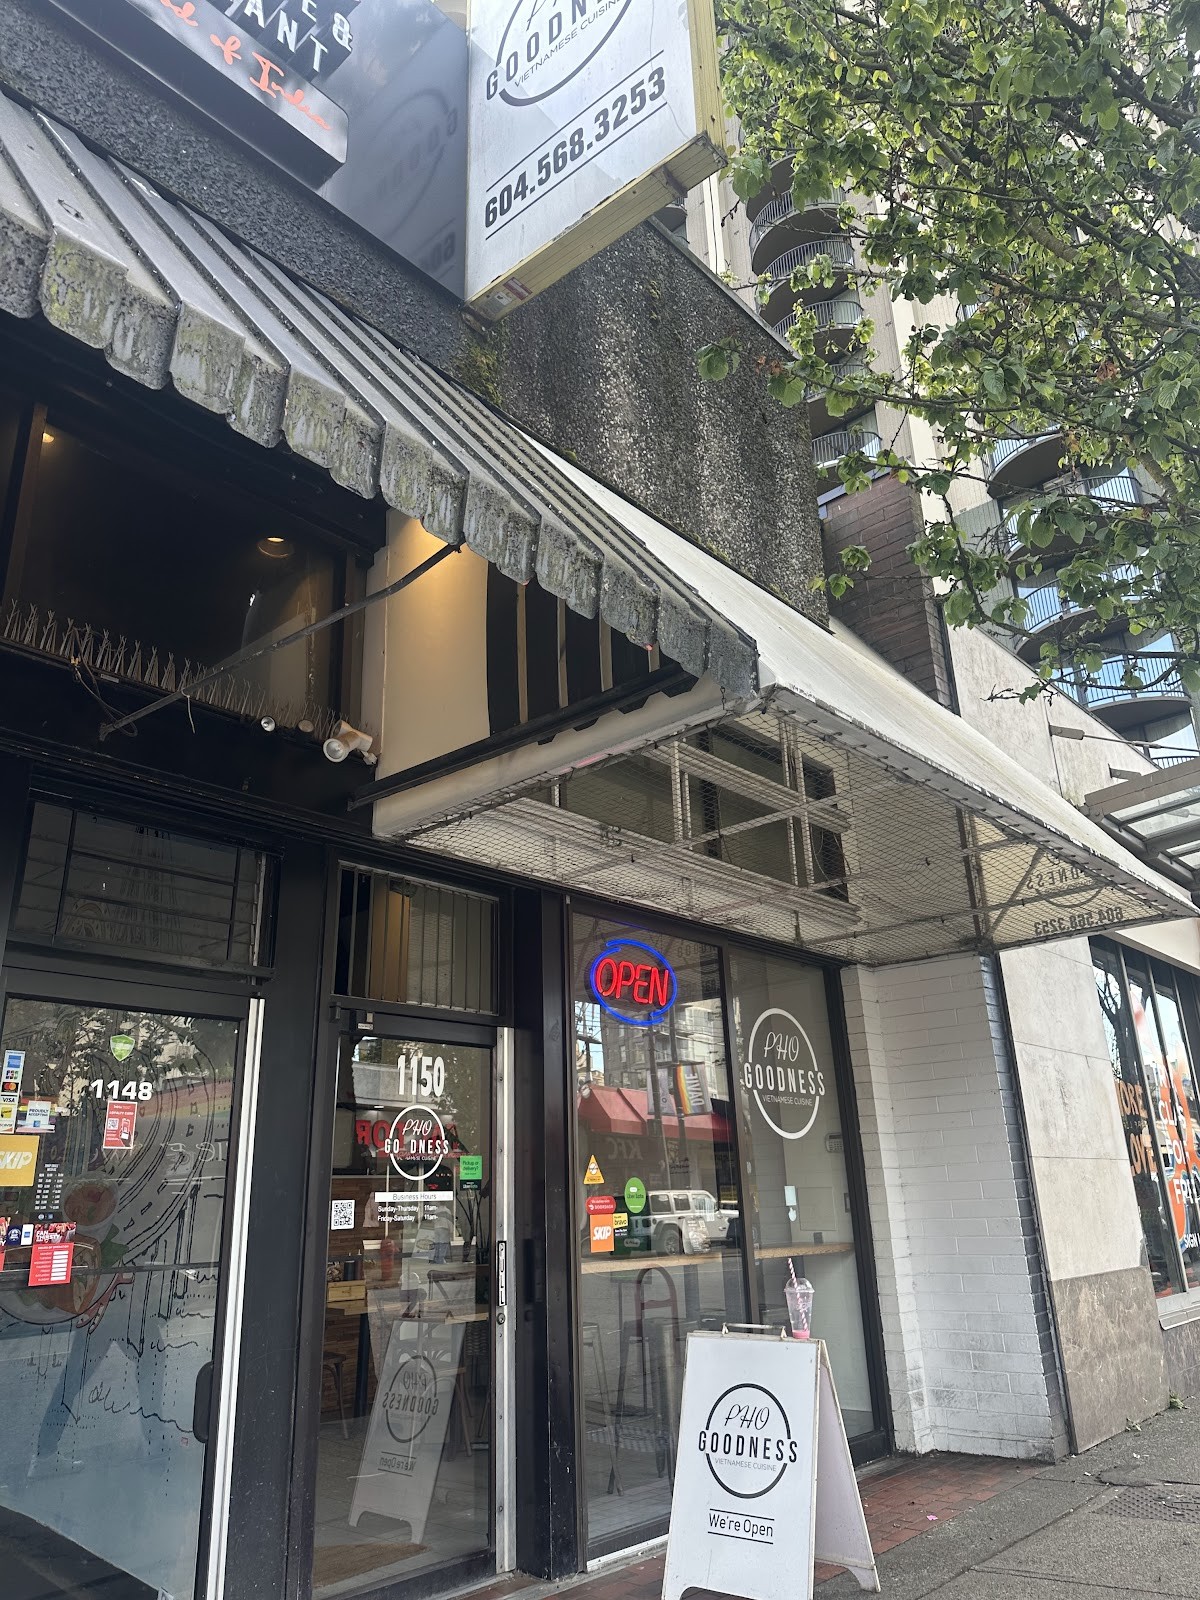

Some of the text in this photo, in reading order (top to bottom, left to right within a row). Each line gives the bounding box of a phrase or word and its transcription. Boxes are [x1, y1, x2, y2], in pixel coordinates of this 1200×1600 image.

[514, 28, 578, 88] VIETNAMESE
[484, 66, 666, 229] 604.568.3253
[596, 957, 670, 1007] OPEN
[764, 1031, 799, 1062] PHO
[397, 1054, 445, 1097] 1150
[744, 1062, 825, 1096] GOODNESS
[90, 1079, 153, 1101] 1148
[762, 1094, 813, 1106] VIETNAMESE CUISINE
[402, 1119, 433, 1136] PHO
[419, 1192, 437, 1200] Hours
[593, 1225, 612, 1240] SKIP
[724, 1403, 770, 1430] PHO
[698, 1430, 798, 1463] GOODNESS
[714, 1457, 777, 1472] VIETNAMESE CUISINE
[709, 1512, 774, 1538] We're Open
